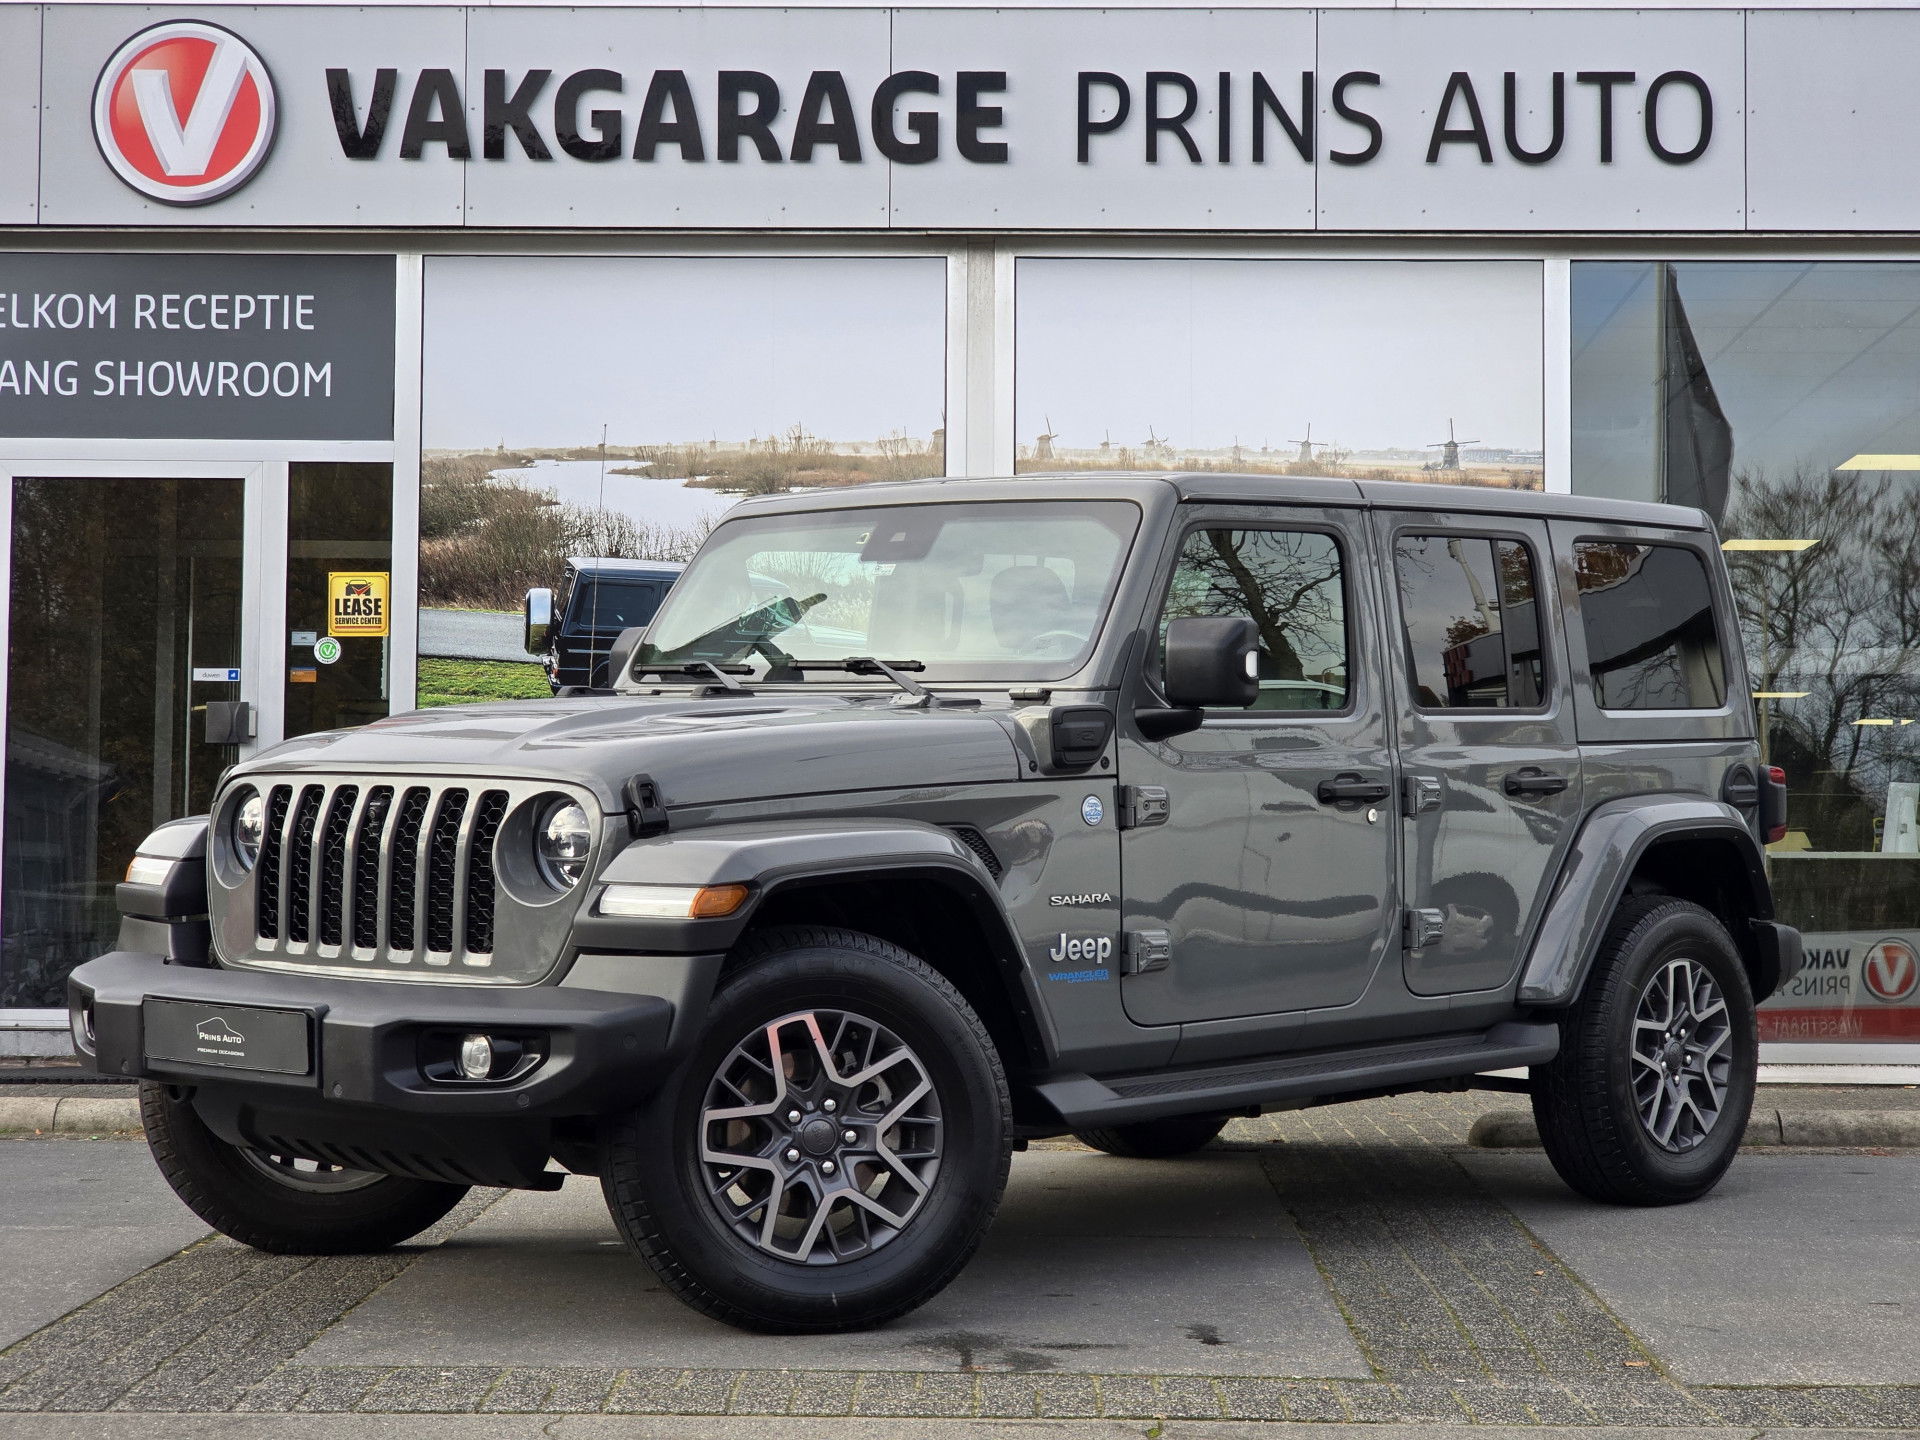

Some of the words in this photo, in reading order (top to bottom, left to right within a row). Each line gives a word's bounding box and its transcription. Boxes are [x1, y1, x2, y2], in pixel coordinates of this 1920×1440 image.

[325, 68, 1009, 164] VAKGARAGE
[1077, 71, 1383, 165] PRINS
[1425, 70, 1713, 165] AUTO
[134, 294, 315, 331] RECEPTIE
[93, 361, 332, 397] SHOWROOM
[334, 598, 382, 616] LEASE
[334, 617, 359, 625] SERVICE
[360, 617, 382, 625] CENTER
[1050, 893, 1112, 906] SAHARA
[1050, 933, 1112, 964] Jeep
[1048, 968, 1109, 981] WRANGLER
